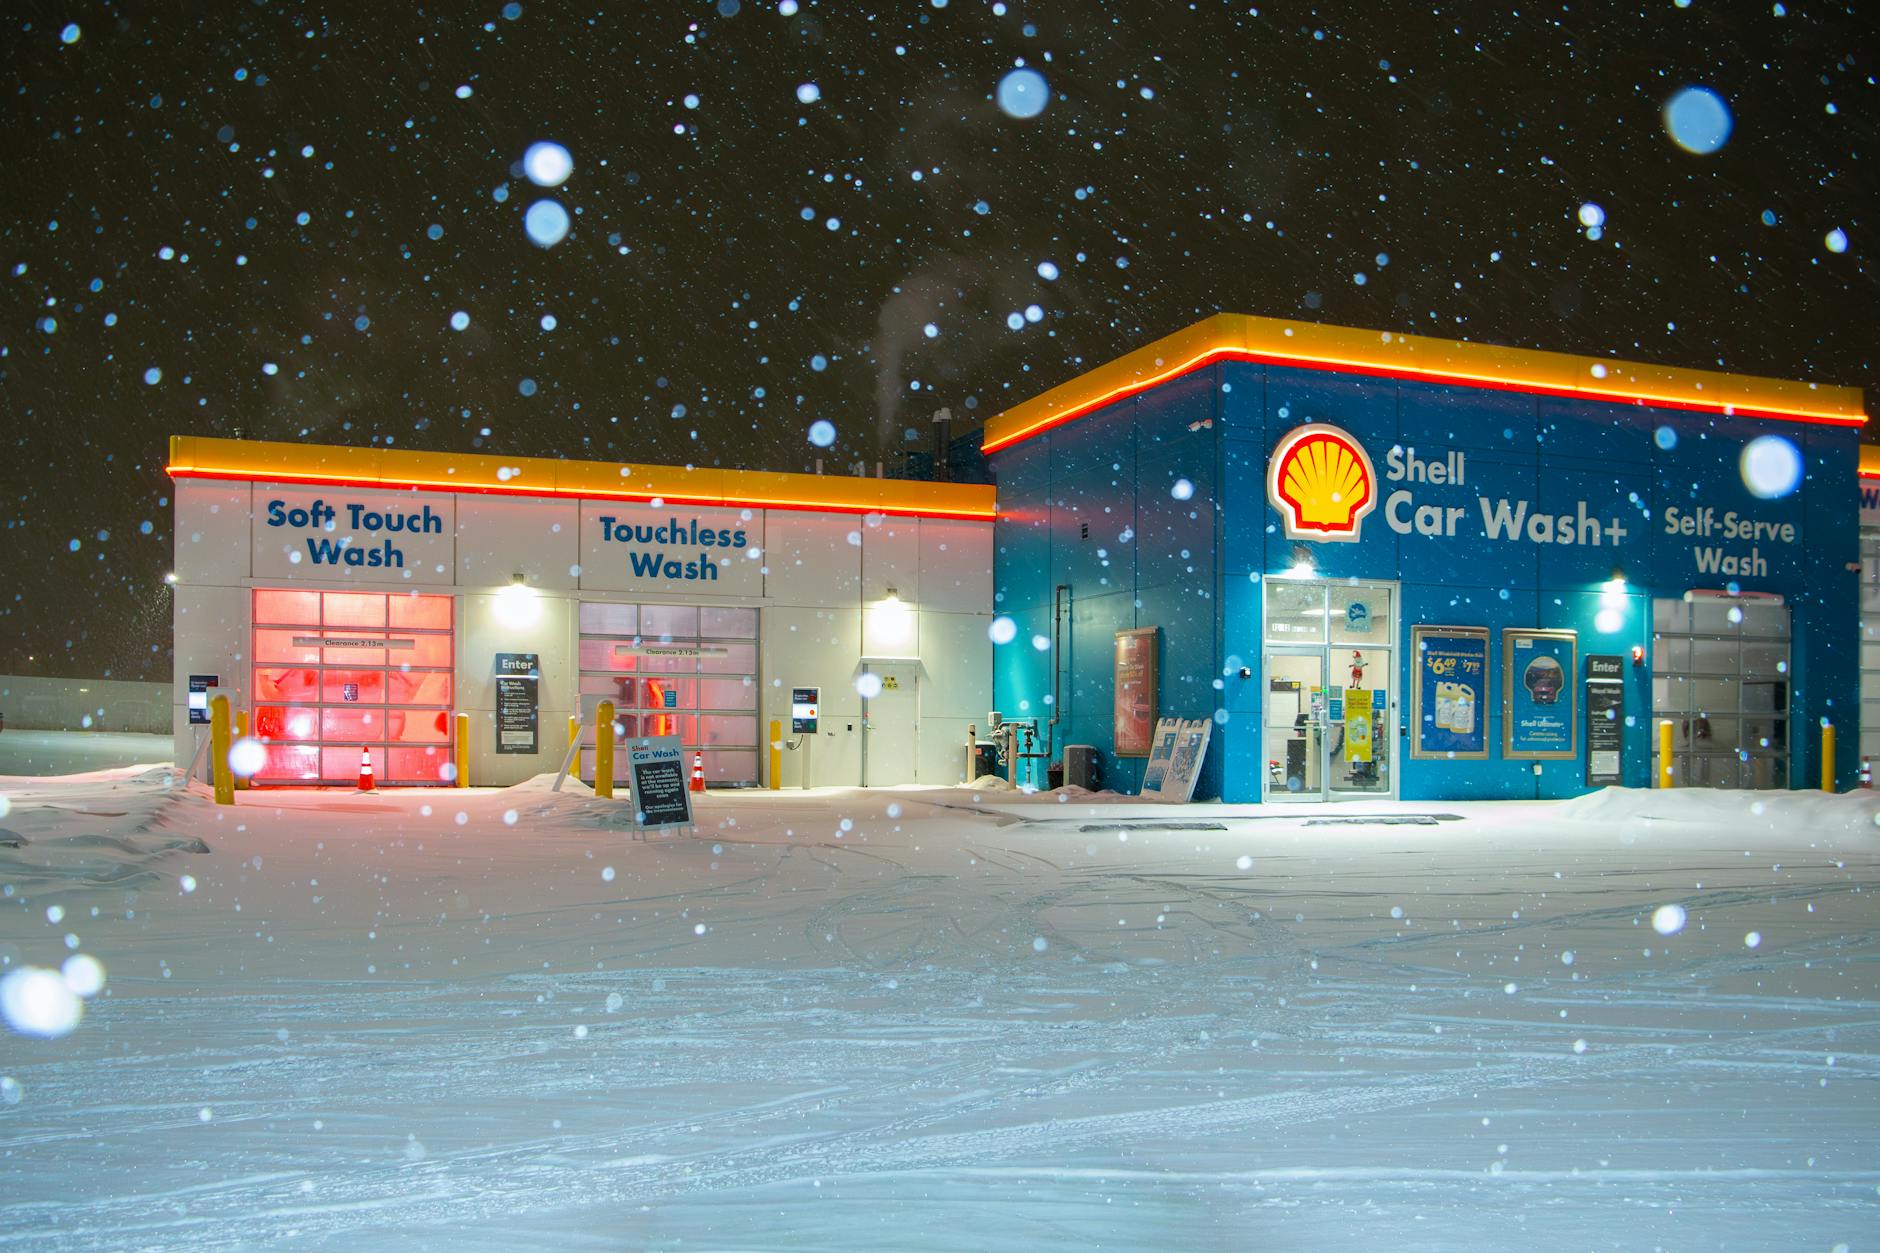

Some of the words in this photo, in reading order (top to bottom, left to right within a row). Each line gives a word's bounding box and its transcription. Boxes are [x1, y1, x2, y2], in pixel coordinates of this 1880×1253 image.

[1386, 446, 1465, 486] Shell
[267, 499, 336, 528] Soft
[347, 503, 442, 534] Touch
[600, 516, 747, 548] Touchless
[1385, 490, 1465, 537] Car
[1479, 496, 1627, 547] Wash+
[1664, 505, 1795, 543] Self-Serve
[307, 538, 404, 568] Wash
[630, 552, 718, 580] Wash
[1694, 545, 1768, 577] Wash
[325, 639, 359, 647] Clearance
[502, 658, 533, 670] Enter
[1592, 660, 1619, 672] Enter
[633, 752, 650, 760] Car
[652, 748, 679, 758] Wash
